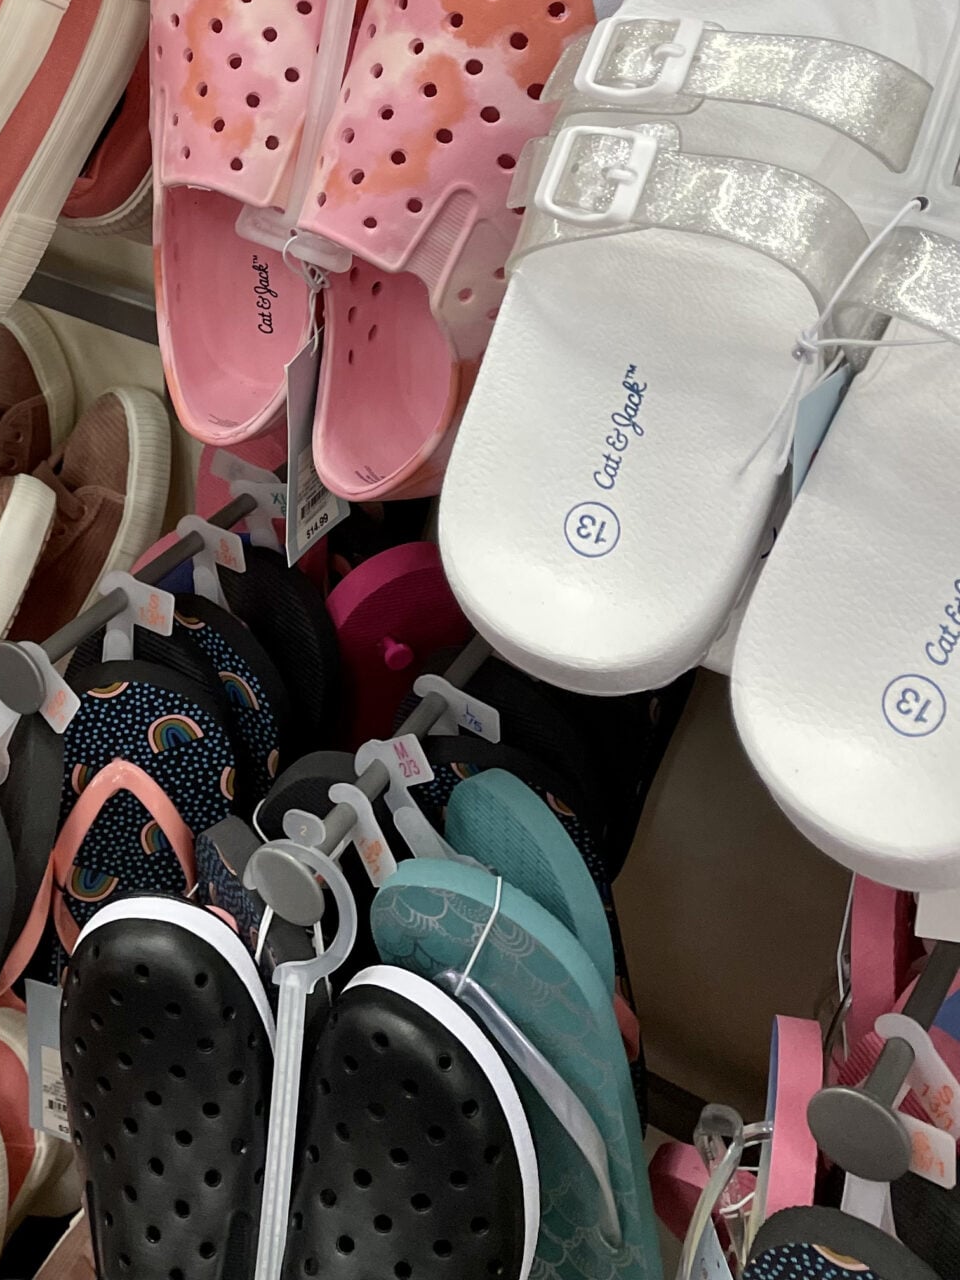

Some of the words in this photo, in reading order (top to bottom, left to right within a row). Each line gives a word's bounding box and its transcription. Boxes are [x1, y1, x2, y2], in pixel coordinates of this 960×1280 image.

[257, 291, 272, 308] &
[257, 308, 273, 335] Cat
[605, 427, 629, 452] &
[593, 453, 623, 490] Cat
[306, 512, 329, 540] $14.99
[575, 514, 608, 545] 13
[925, 623, 960, 666] Cat
[896, 687, 932, 724] 13
[393, 741, 409, 761] M
[300, 826, 308, 836] 2
